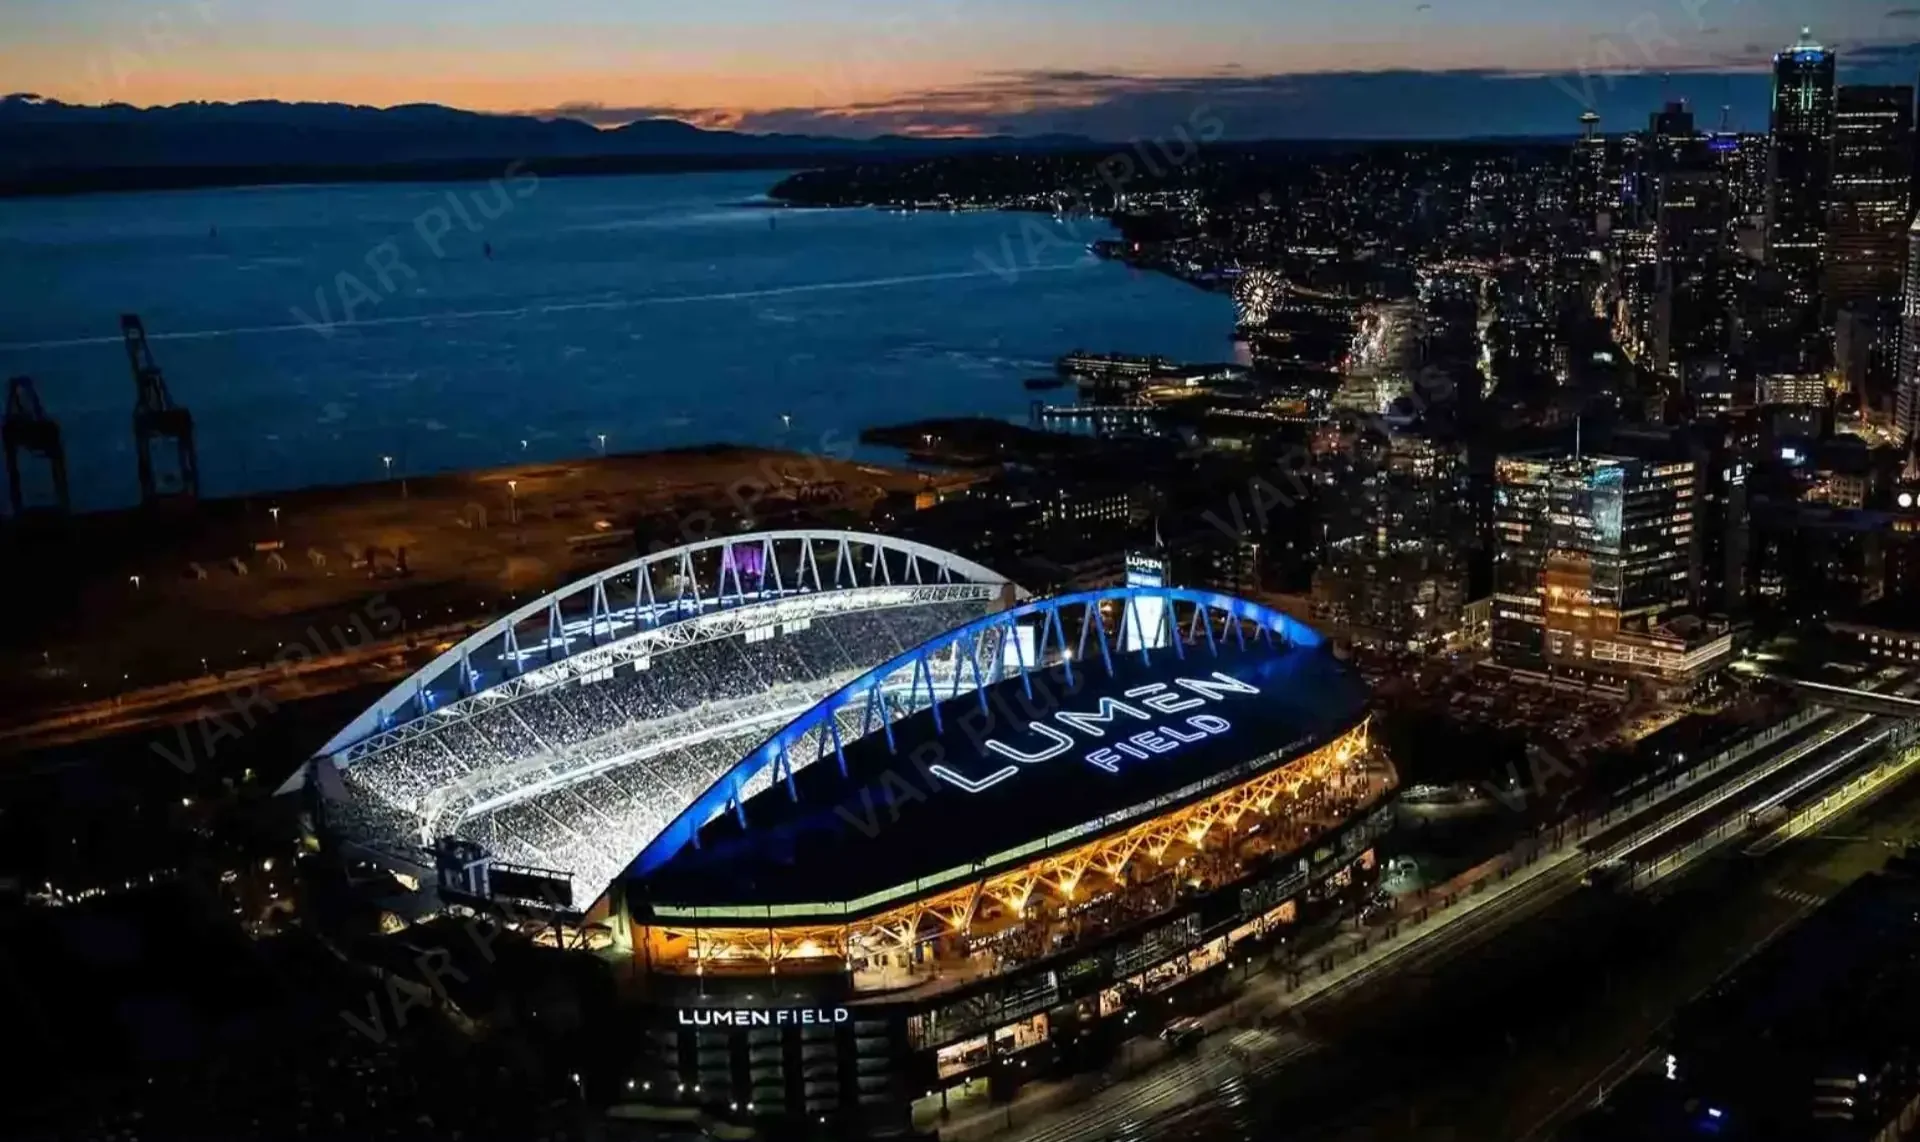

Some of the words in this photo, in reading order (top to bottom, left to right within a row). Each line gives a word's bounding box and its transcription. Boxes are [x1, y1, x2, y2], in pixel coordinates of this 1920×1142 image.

[1126, 555, 1162, 569] LUMEN
[929, 671, 1260, 792] LUMEN
[1085, 715, 1231, 773] FIELD
[678, 1009, 770, 1026] LUMEN
[776, 1008, 849, 1024] FIELD
